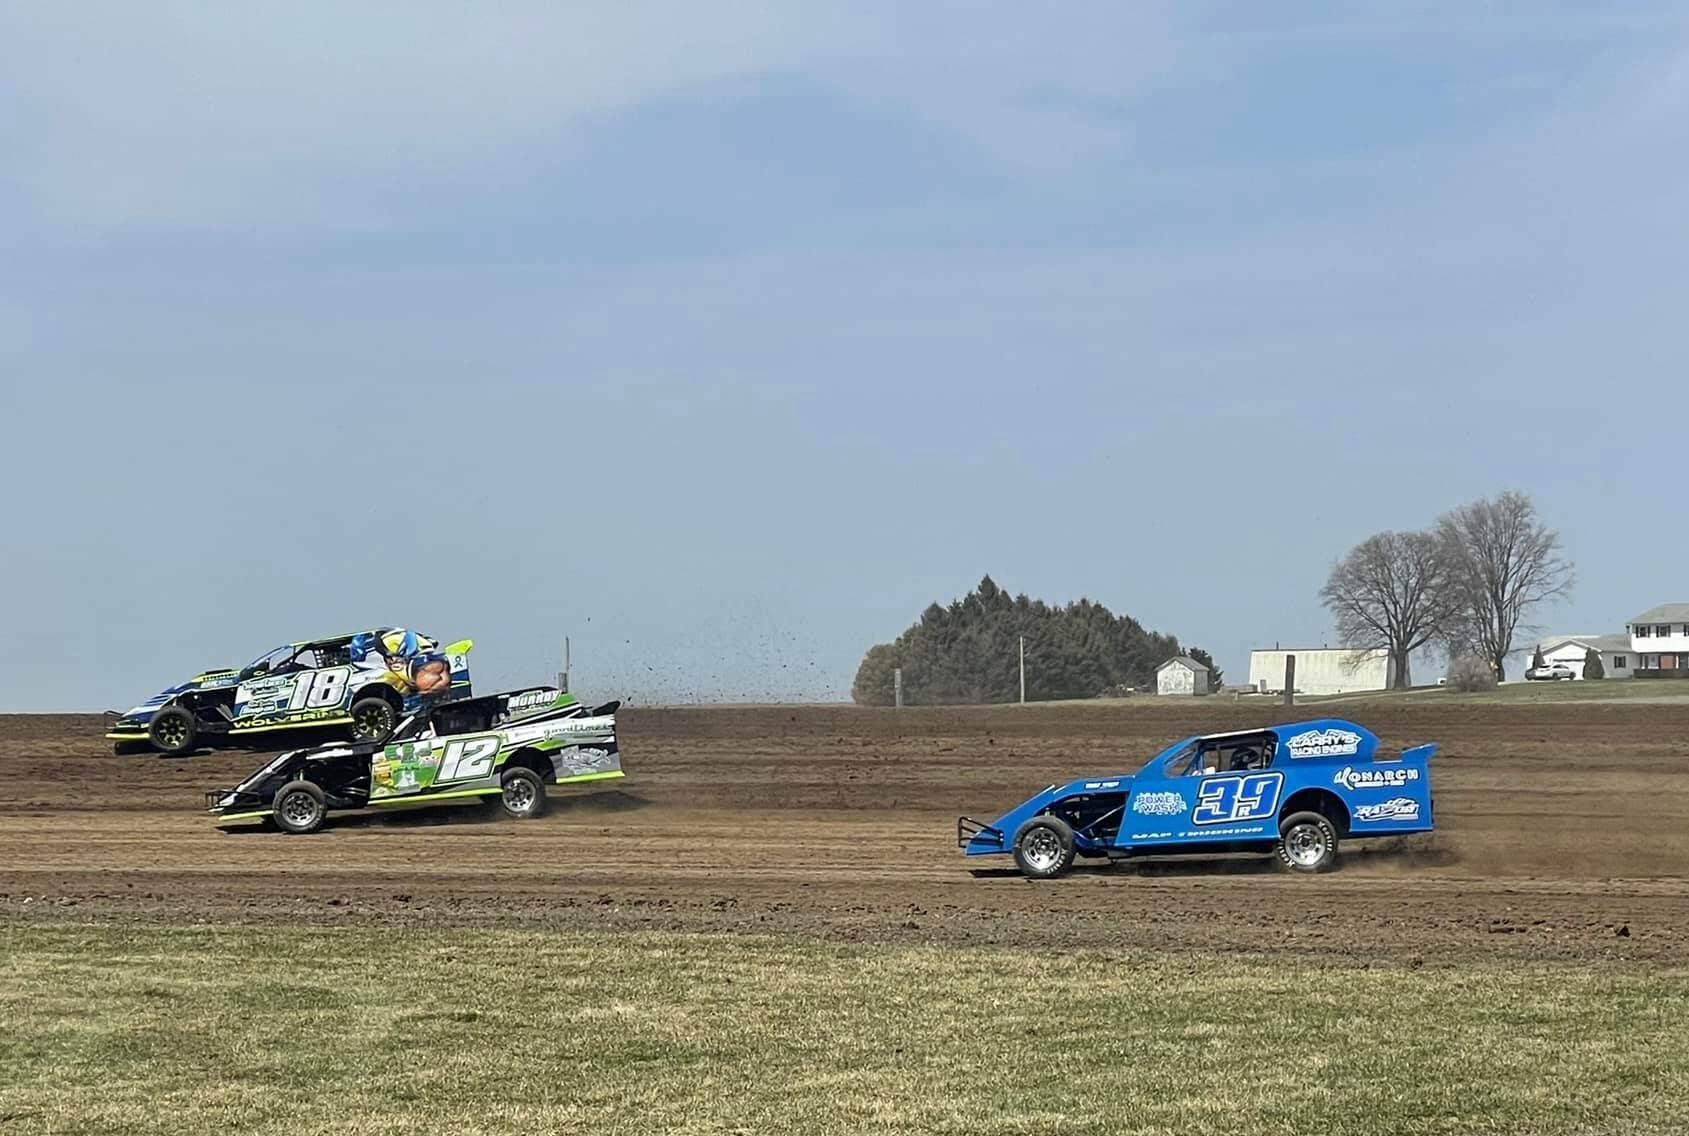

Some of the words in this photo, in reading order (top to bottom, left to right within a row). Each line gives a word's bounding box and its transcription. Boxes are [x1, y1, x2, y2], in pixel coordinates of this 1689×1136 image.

[288, 667, 350, 712] 18
[1292, 734, 1356, 749] LARRY'S
[435, 738, 500, 783] 12
[1333, 766, 1418, 790] MONARCH
[1138, 795, 1181, 804] POWER
[1143, 803, 1178, 813] WASH
[1192, 773, 1285, 824] 39
[1238, 806, 1250, 816] R
